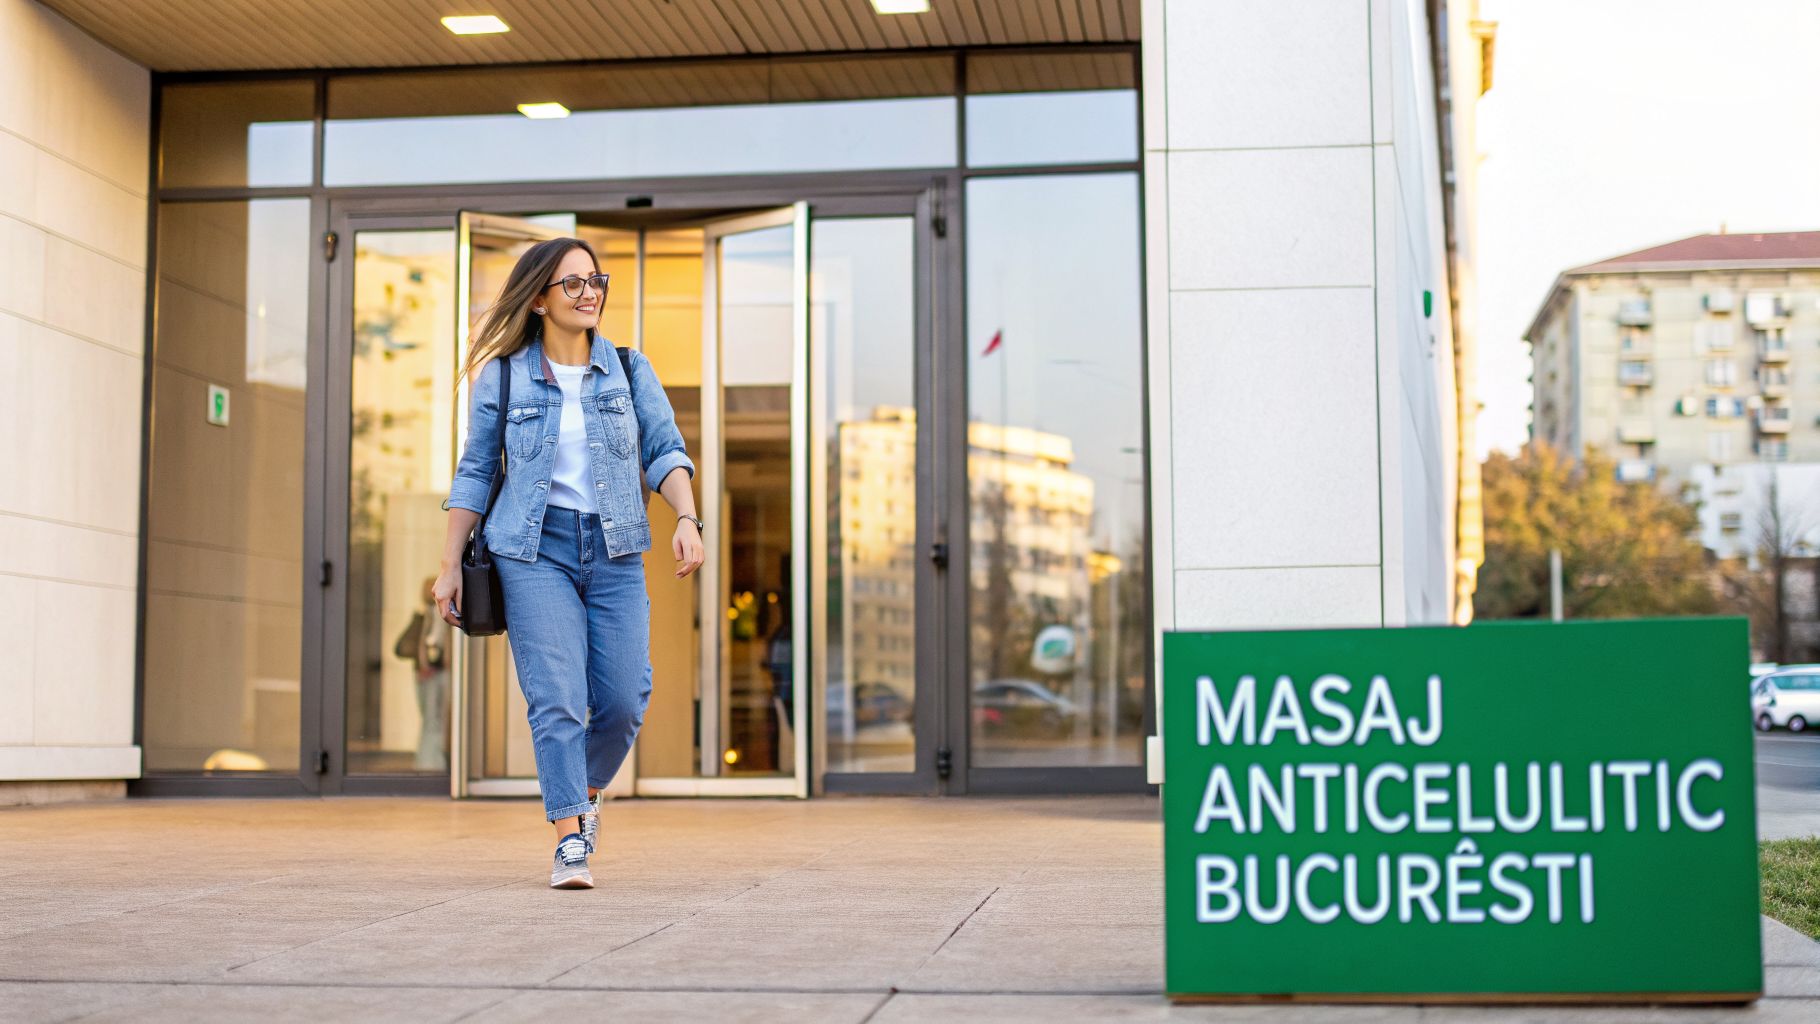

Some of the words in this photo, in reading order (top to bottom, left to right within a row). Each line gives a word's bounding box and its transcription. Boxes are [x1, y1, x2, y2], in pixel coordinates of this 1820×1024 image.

[1196, 674, 1443, 745] MASAJ
[1195, 760, 1725, 833] ANTICELULITIC
[1196, 838, 1594, 924] BUCURÊSTI
